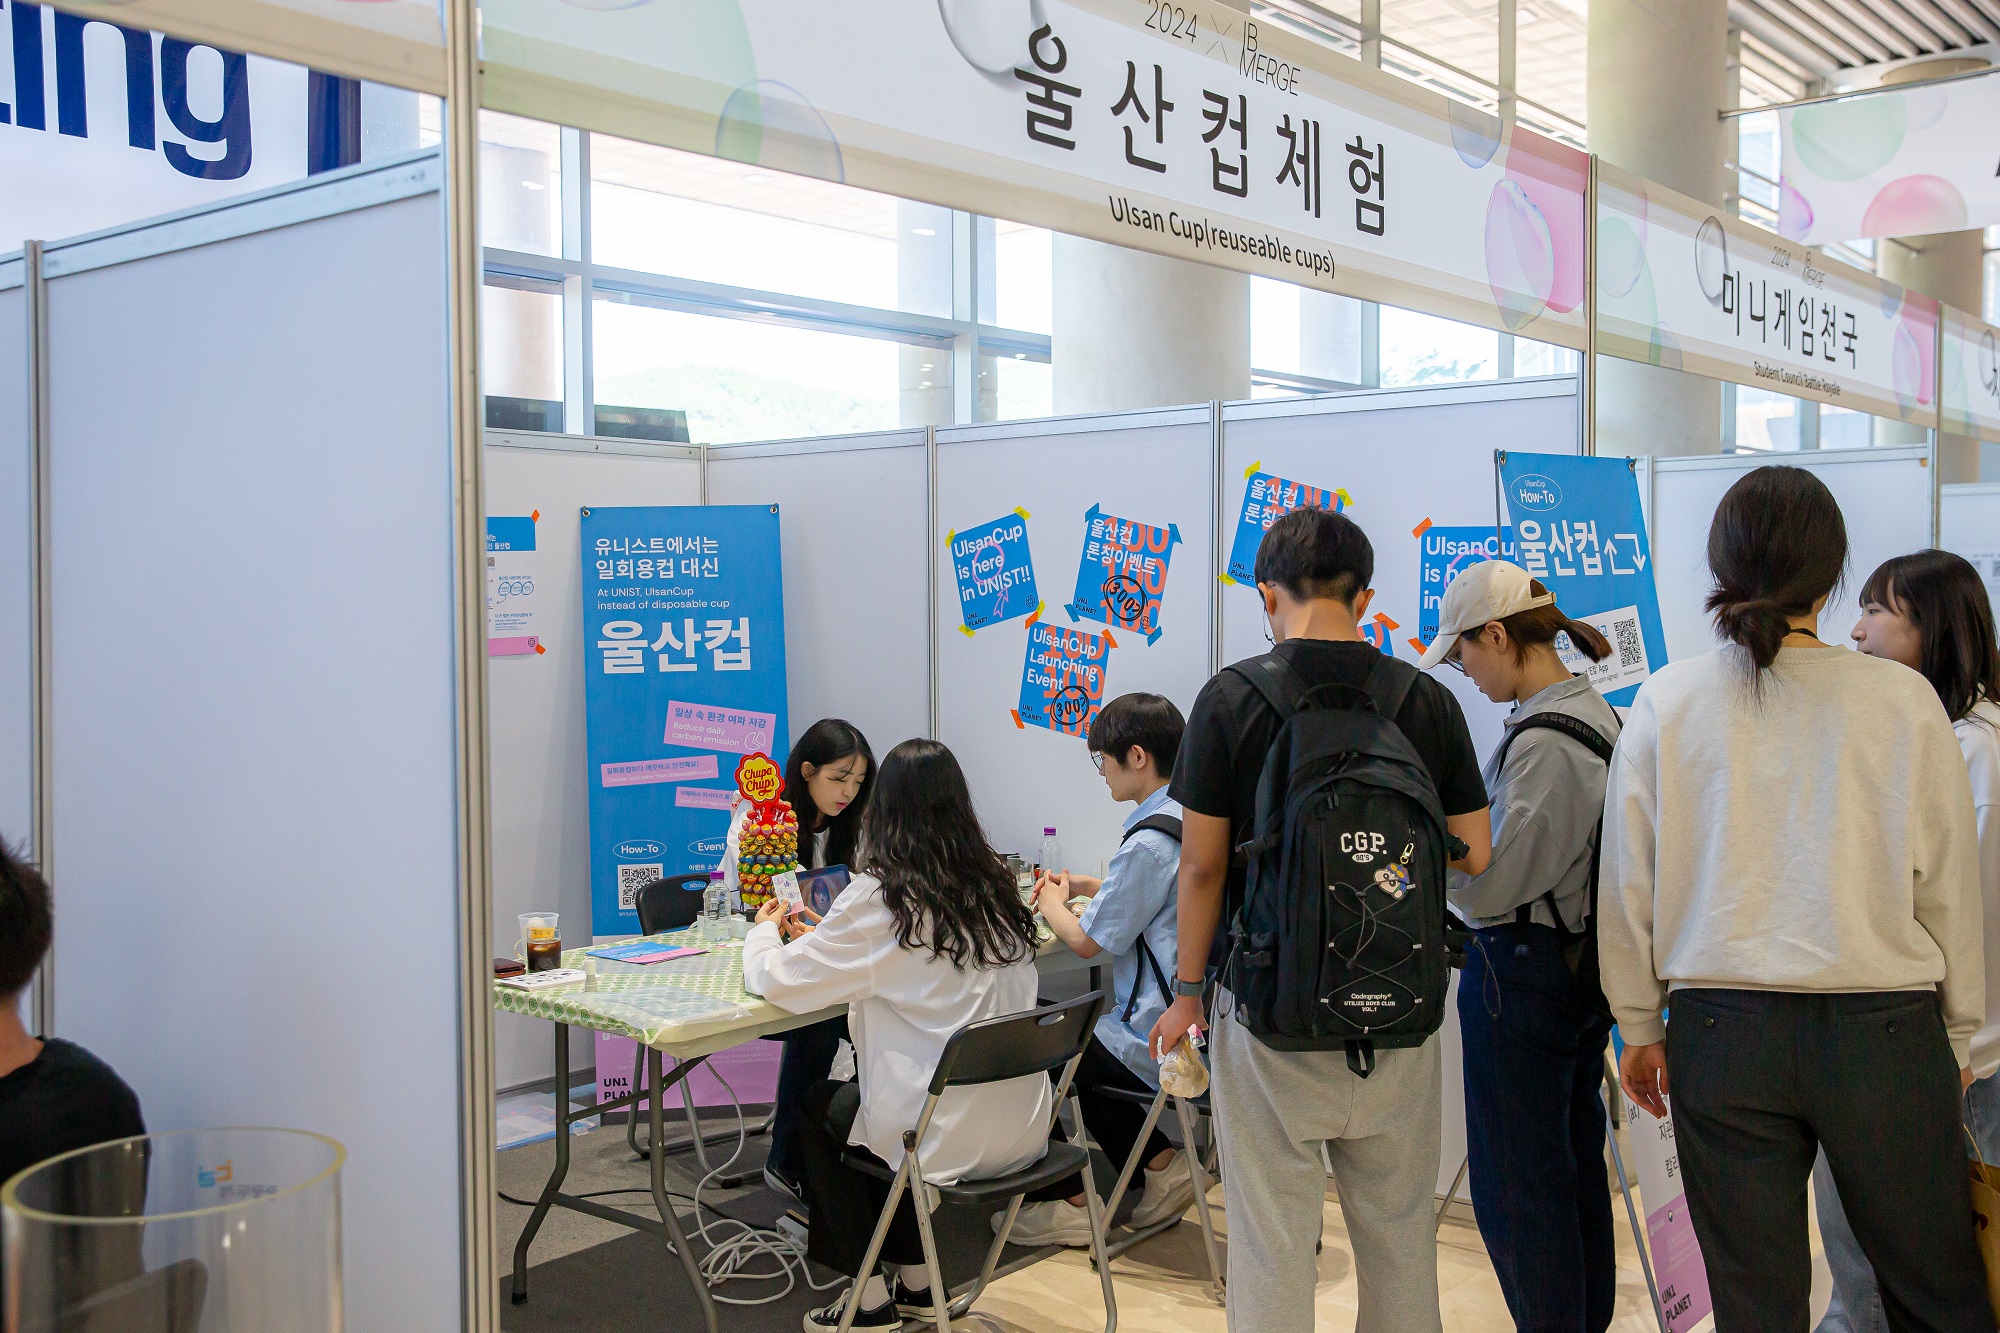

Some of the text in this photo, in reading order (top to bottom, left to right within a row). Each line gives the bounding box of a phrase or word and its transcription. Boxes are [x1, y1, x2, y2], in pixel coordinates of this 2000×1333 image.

[1145, 0, 1197, 43] 2024
[1239, 50, 1300, 96] MERGE
[0, 0, 252, 180] ing
[1109, 196, 1164, 233] Ulsan
[1295, 249, 1335, 279] cups)
[1722, 270, 1858, 369] 미니게임천국
[1251, 479, 1298, 509] 울산컵
[1525, 479, 1546, 488] UlsanCup
[1519, 488, 1555, 504] How-To
[954, 525, 1022, 557] UlsanCup
[1091, 518, 1133, 546] 울산컵
[594, 536, 718, 556] 유니스트에서는
[1086, 540, 1156, 574] 론칭이벤트
[1519, 519, 1603, 577] 울산컵
[595, 558, 719, 580] 일회용컵 대신
[957, 555, 1004, 580] is here
[1230, 570, 1254, 581] PLANET
[1425, 563, 1440, 583] is
[597, 586, 694, 598] At UNIST, UlsanCup
[961, 565, 1031, 602] in UNIST!!
[597, 599, 730, 611] instead of disposable cup
[1075, 604, 1097, 615] PLANET
[968, 617, 988, 627] PLANET
[597, 617, 751, 674] 울산컵
[1033, 628, 1097, 659] UlsanCup
[1029, 648, 1098, 682] Launching
[1026, 668, 1064, 691] Event
[675, 707, 767, 728] 일상 속 환경 여파 저감
[1021, 712, 1043, 721] PLANET
[672, 732, 740, 747] carbon emission
[673, 721, 726, 736] Reduce daily
[744, 767, 772, 779] Chupa
[746, 778, 775, 796] Chups
[621, 844, 659, 854] How-To
[697, 843, 725, 852] Event
[1341, 832, 1387, 854] CGP.
[1665, 1294, 1693, 1323] PLANET
